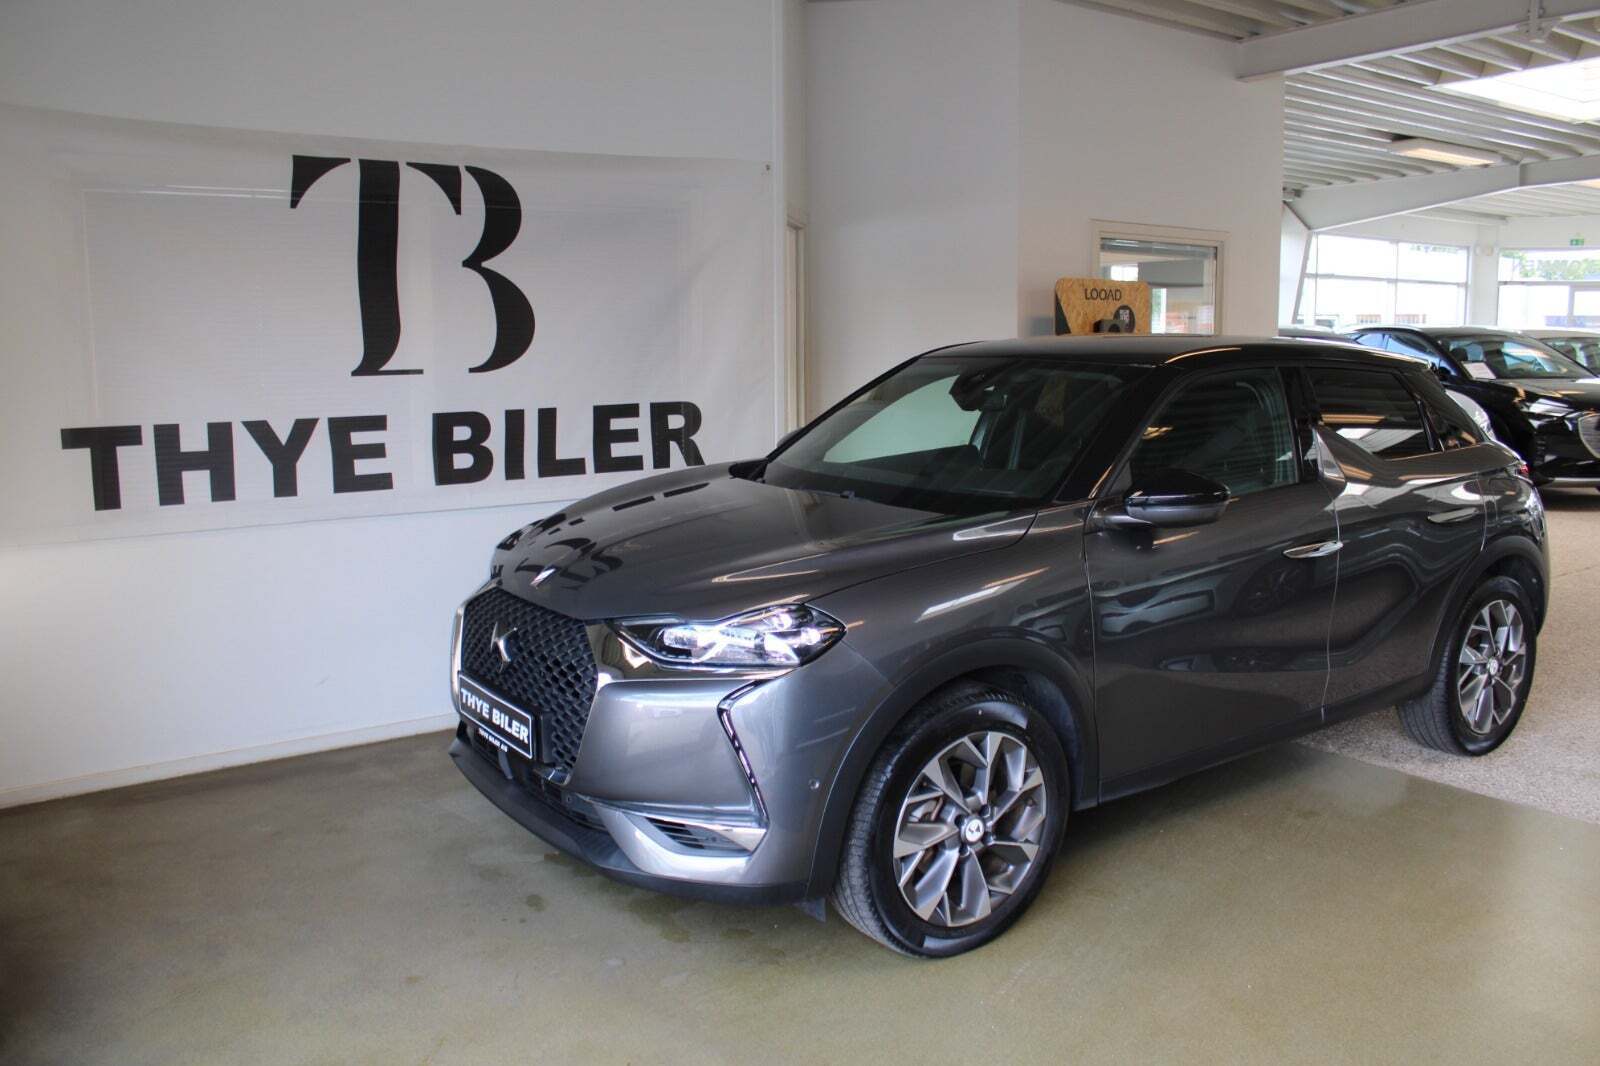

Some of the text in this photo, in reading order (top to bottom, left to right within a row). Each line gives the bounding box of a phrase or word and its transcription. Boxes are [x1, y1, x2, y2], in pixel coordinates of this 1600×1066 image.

[60, 401, 706, 511] THYE BILER
[460, 687, 529, 744] THYE BILER
